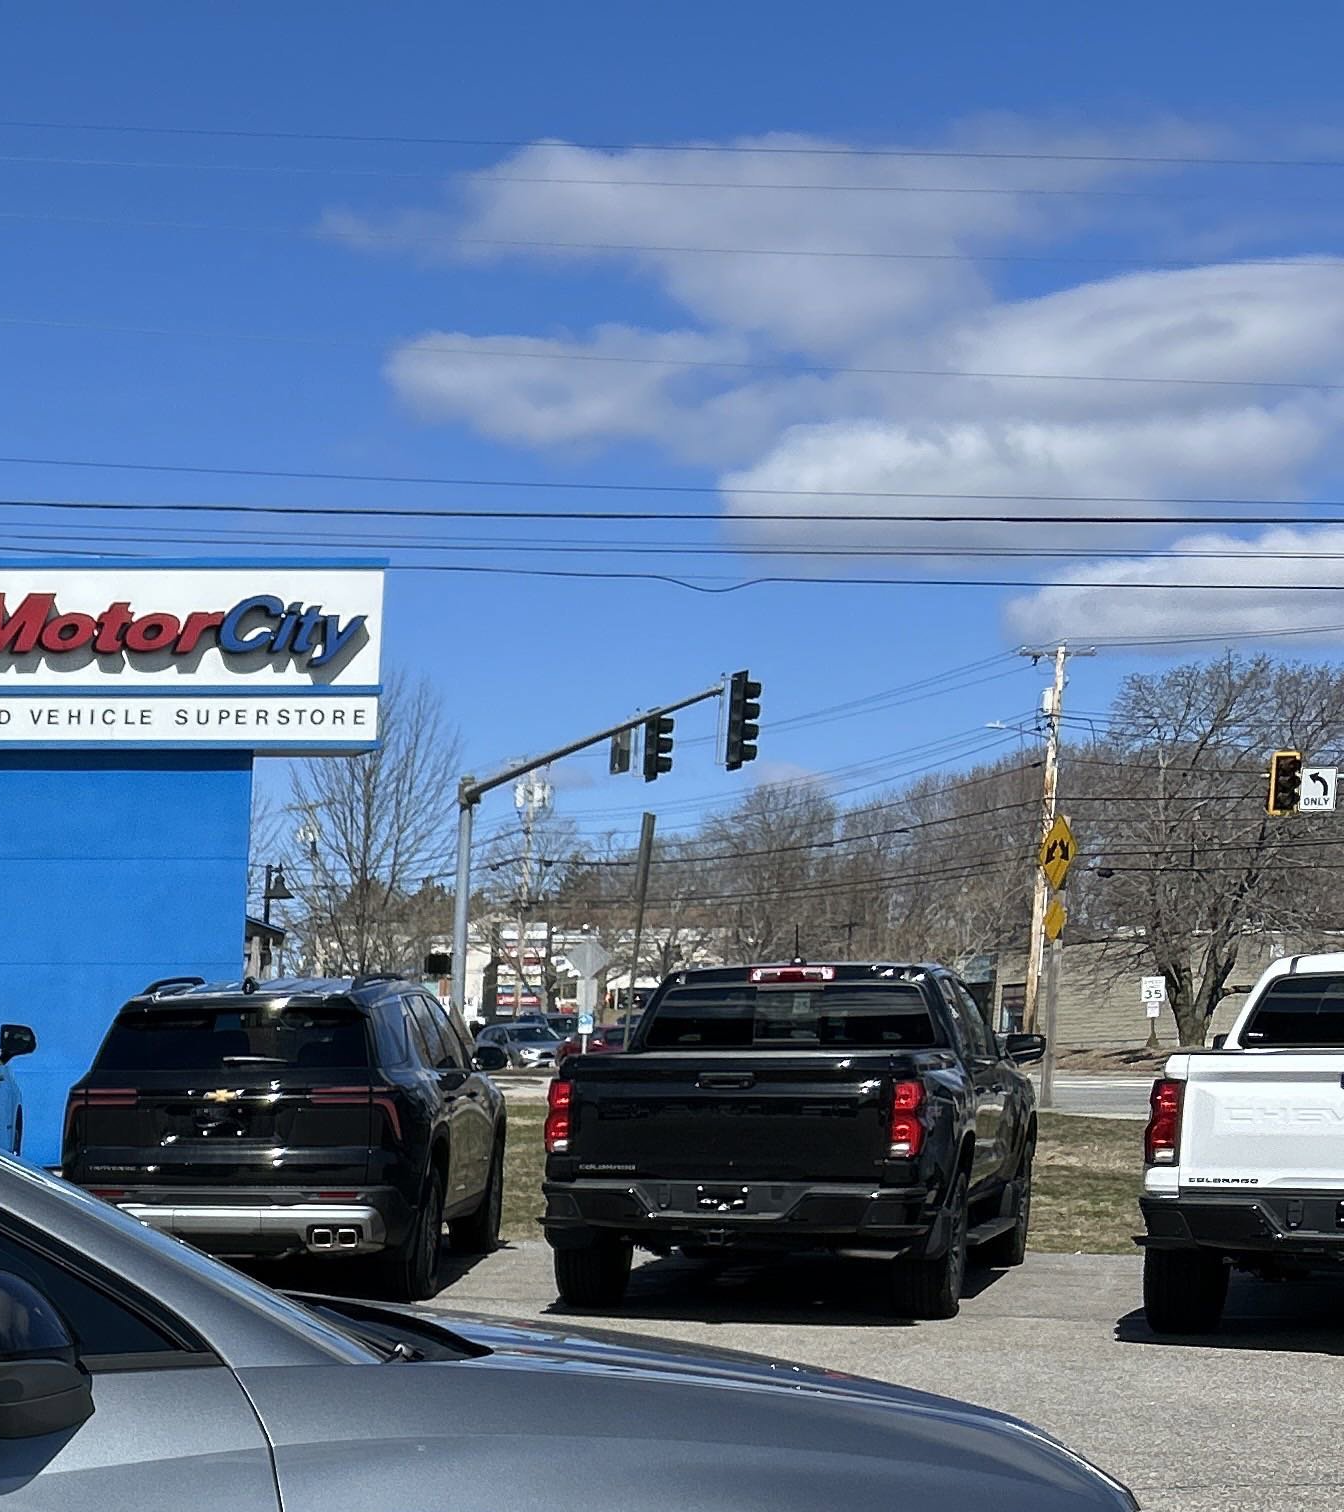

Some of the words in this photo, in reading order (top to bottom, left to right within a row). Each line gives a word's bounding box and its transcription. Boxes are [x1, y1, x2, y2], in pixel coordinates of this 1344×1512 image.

[30, 708, 152, 725] VEHICLE
[174, 708, 365, 726] SUPERSTORE
[1303, 797, 1330, 806] ONLY
[1144, 989, 1163, 1000] 35
